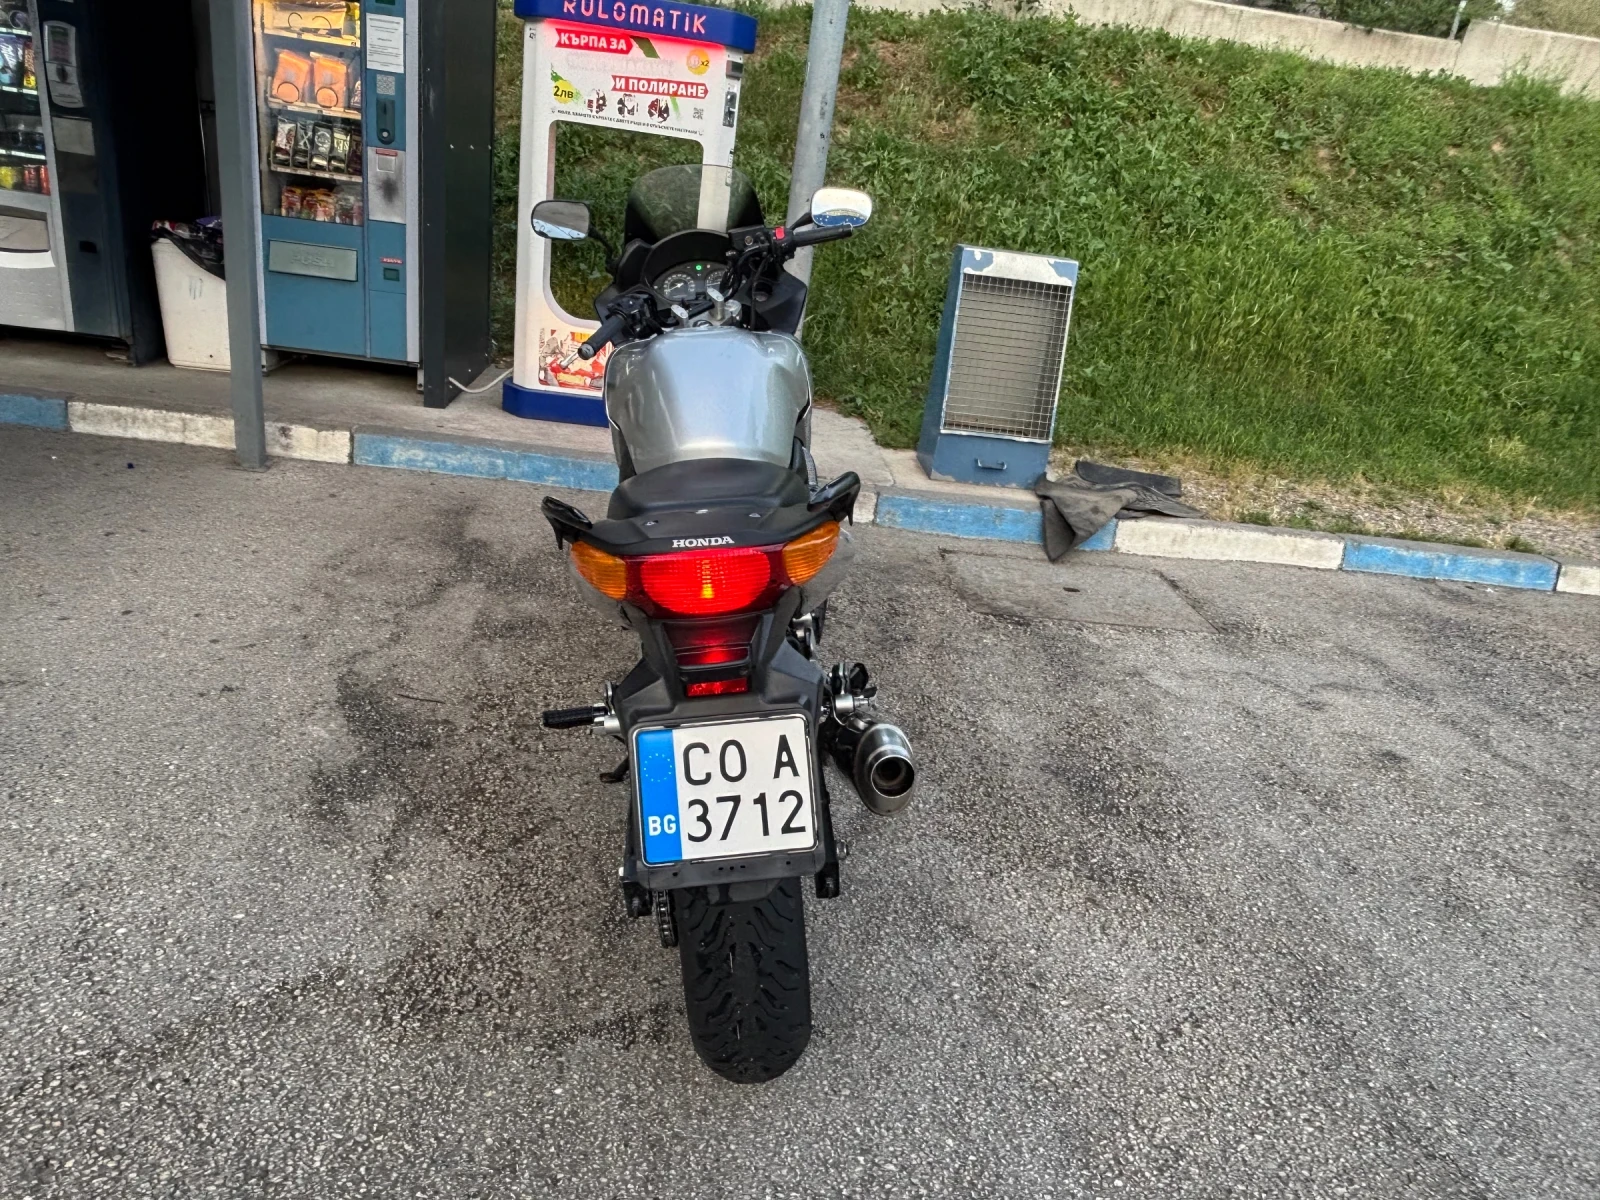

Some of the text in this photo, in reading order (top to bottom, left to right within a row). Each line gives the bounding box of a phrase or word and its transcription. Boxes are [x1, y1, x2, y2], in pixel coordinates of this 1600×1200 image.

[563, 0, 707, 35] RULOMATIK
[560, 32, 627, 51] КЪРПА ЗА
[615, 77, 706, 97] И ПОЛИРАНЕ
[672, 535, 735, 548] HONDA
[683, 734, 800, 786] CO A
[647, 815, 677, 837] BG
[687, 789, 807, 843] 3712
